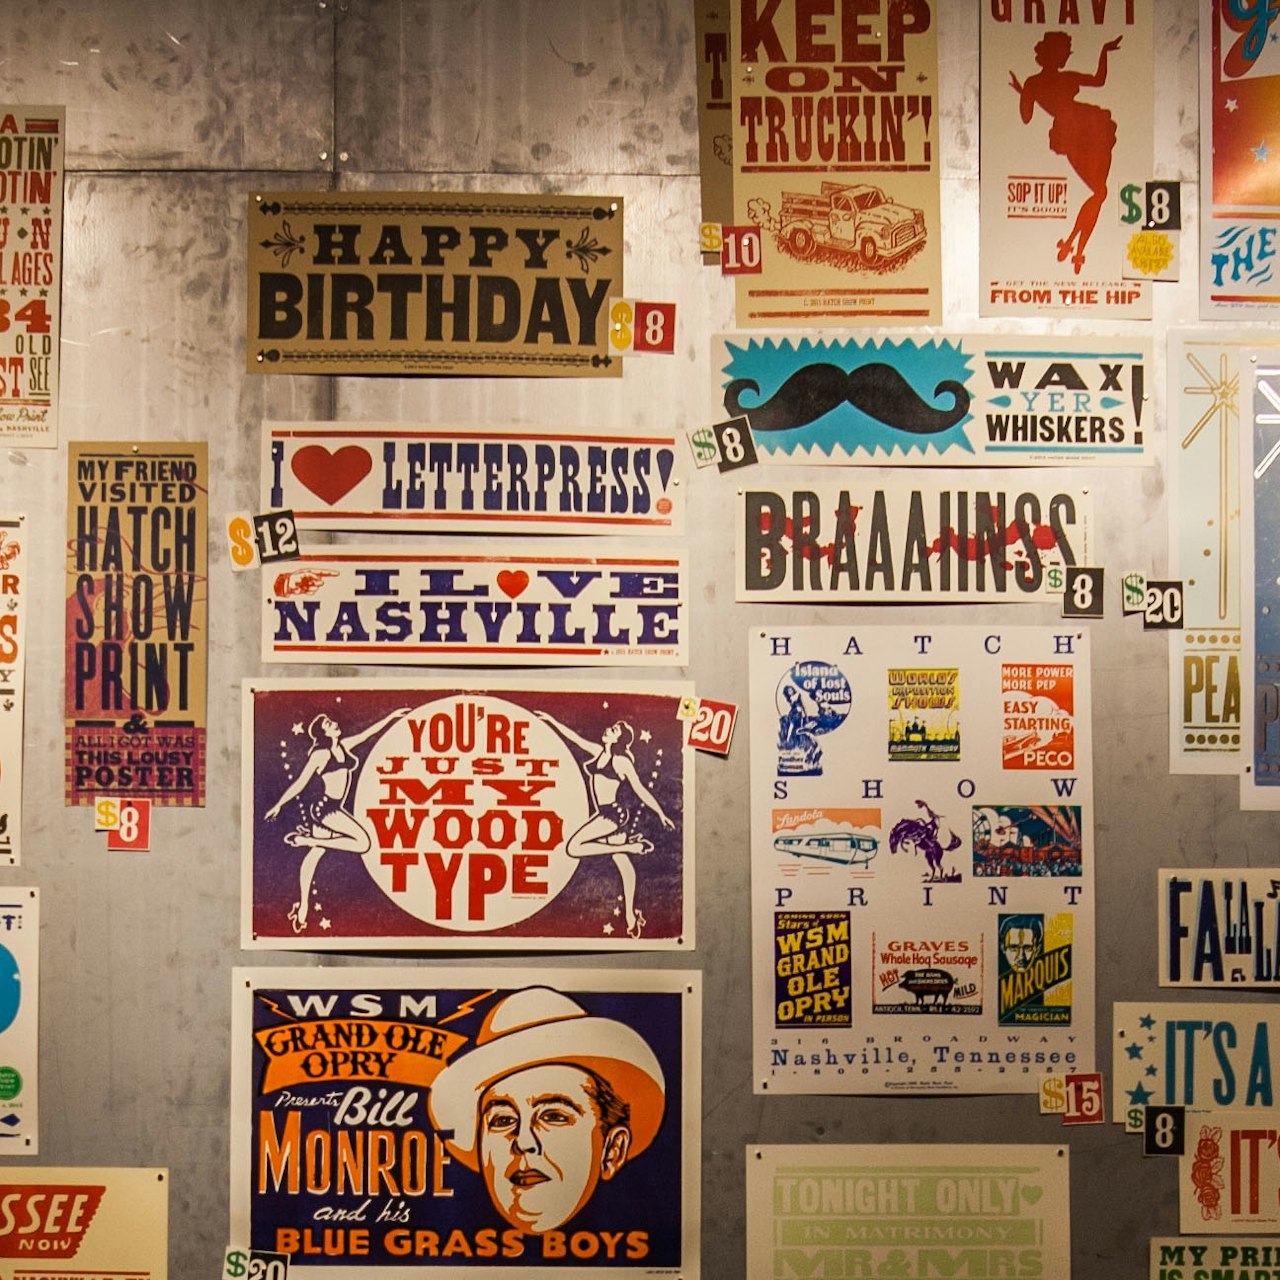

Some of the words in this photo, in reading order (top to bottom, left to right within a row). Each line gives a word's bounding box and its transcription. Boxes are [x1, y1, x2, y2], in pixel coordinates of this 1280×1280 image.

[741, 0, 930, 62] KEEP
[764, 67, 905, 92] ON
[741, 97, 932, 164] TRUCKIN'!
[314, 225, 561, 268] HAPPY
[258, 273, 612, 345] BIRTHDAY
[991, 290, 1055, 304] FROM
[1060, 290, 1098, 304] THE
[1105, 291, 1141, 306] HIP
[272, 442, 283, 508] I
[383, 441, 674, 516] LETTERPRESS!
[274, 602, 678, 644] NASHVILLE
[1004, 701, 1038, 714] EASY
[408, 703, 529, 755] YOU'RE
[1004, 718, 1070, 731] STARTING
[75, 751, 122, 765] THIS
[126, 751, 192, 765] LOUSY
[1023, 750, 1072, 766] PECO
[75, 765, 194, 788] POSTER
[367, 809, 564, 850] WOOD
[380, 853, 549, 921] TYPE
[888, 941, 969, 952] GRAVES
[1014, 1013, 1069, 1021] MAGICIAN
[771, 1049, 917, 1066] Nashville,
[933, 1047, 1076, 1063] Tennessee
[258, 1109, 456, 1198] MONROE
[19, 1238, 72, 1251] NOW
[276, 1228, 372, 1256] BLUE
[384, 1229, 524, 1258] GRASS
[543, 1231, 649, 1259] BOYS
